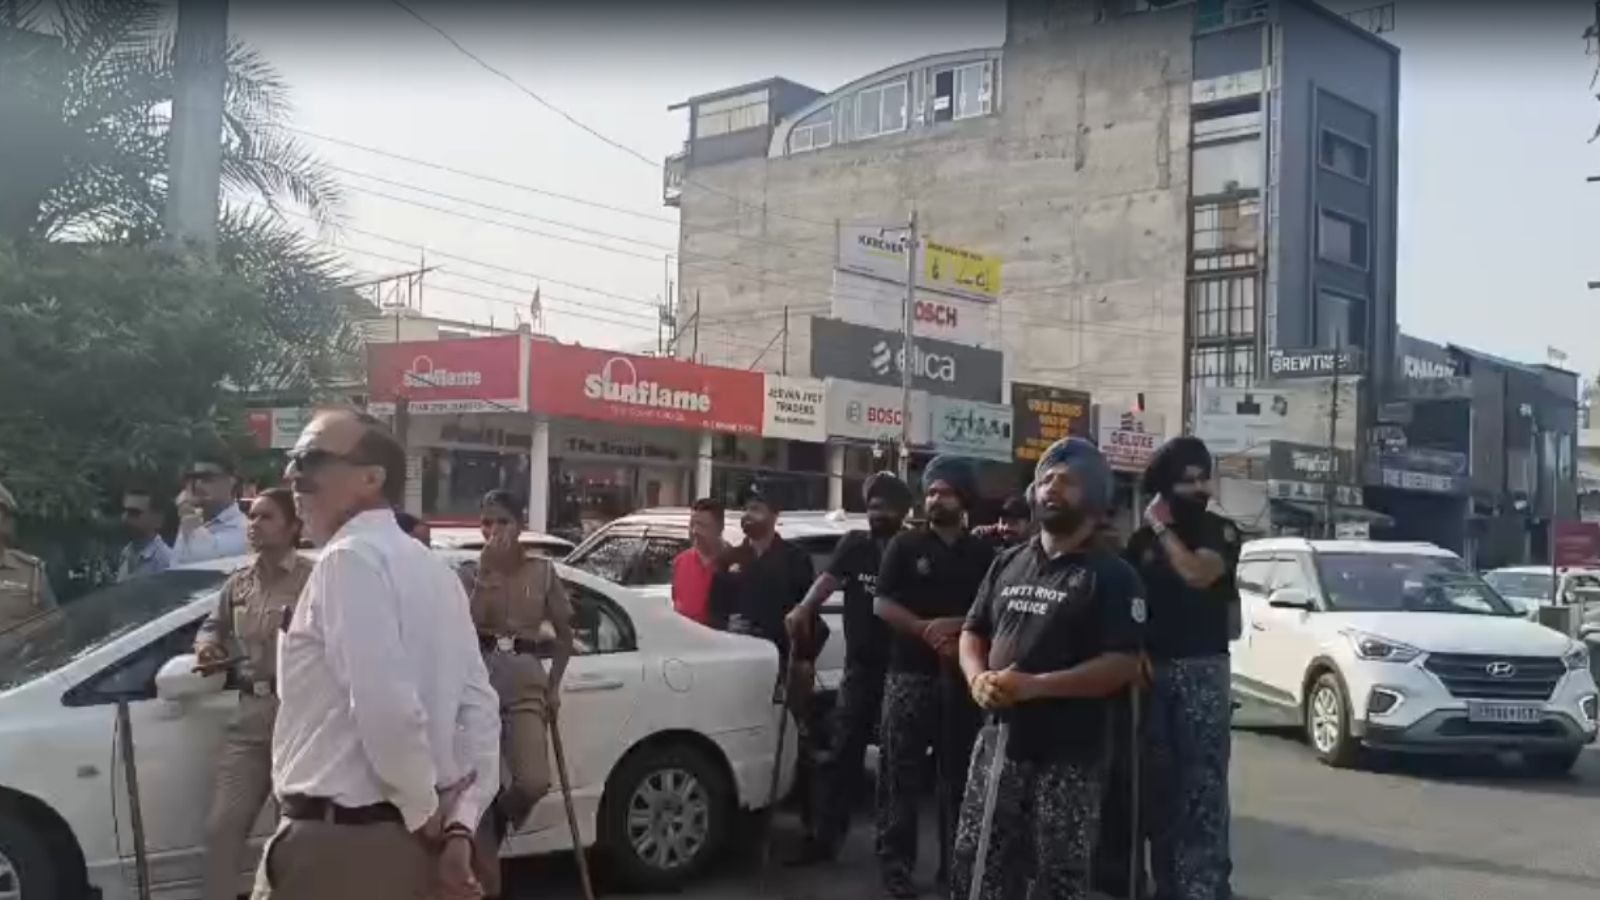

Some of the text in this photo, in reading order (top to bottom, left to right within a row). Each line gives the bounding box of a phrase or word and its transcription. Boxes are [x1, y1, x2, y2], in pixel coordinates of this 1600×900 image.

[584, 363, 711, 412] Sunflame
[1001, 585, 1067, 603] ANTI RIOT
[1007, 599, 1048, 615] POLICE
